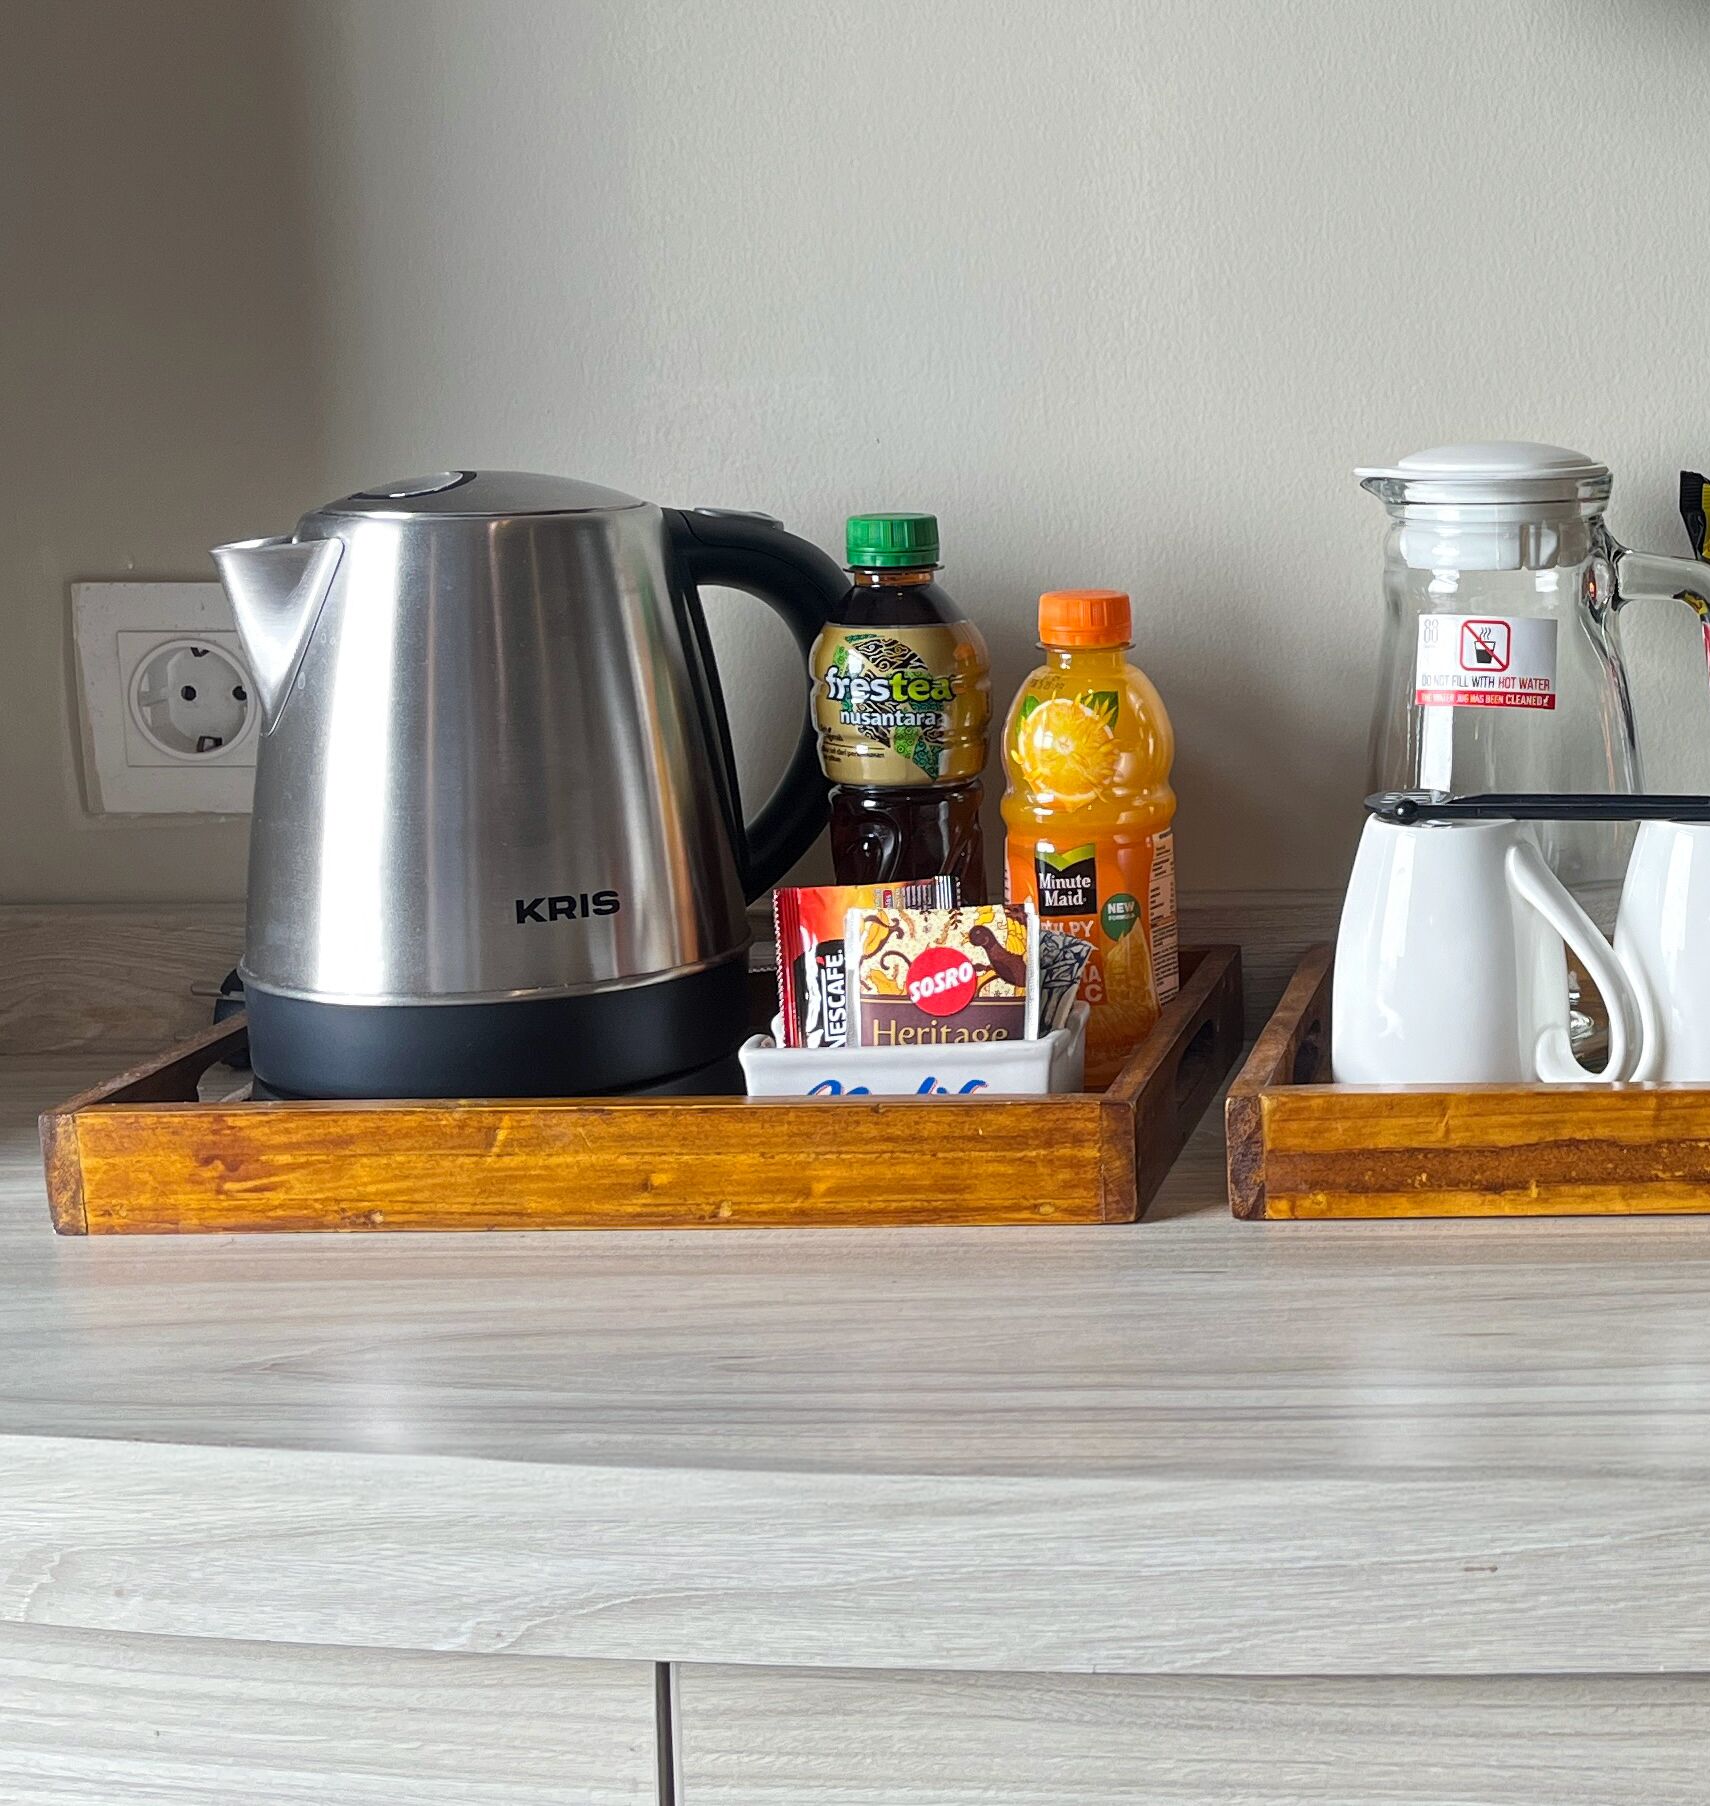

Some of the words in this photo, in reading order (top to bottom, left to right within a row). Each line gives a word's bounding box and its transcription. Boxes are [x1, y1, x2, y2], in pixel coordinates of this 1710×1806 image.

[1423, 618, 1439, 643] 88
[825, 665, 955, 701] frestea
[1452, 676, 1469, 687] FILL
[1472, 676, 1495, 688] WITH
[1498, 677, 1517, 689] HOT
[1518, 677, 1550, 691] WATER
[1470, 694, 1485, 704] HAS
[1485, 695, 1504, 704] BEEN
[1505, 694, 1543, 706] CLEANED
[840, 709, 938, 727] nusantara
[1038, 873, 1092, 890] Minute
[515, 890, 620, 924] KRIS
[1044, 889, 1084, 907] Maid
[1107, 901, 1135, 914] NEW
[908, 961, 974, 1004] SOSRO
[872, 1018, 1008, 1046] Heritage
